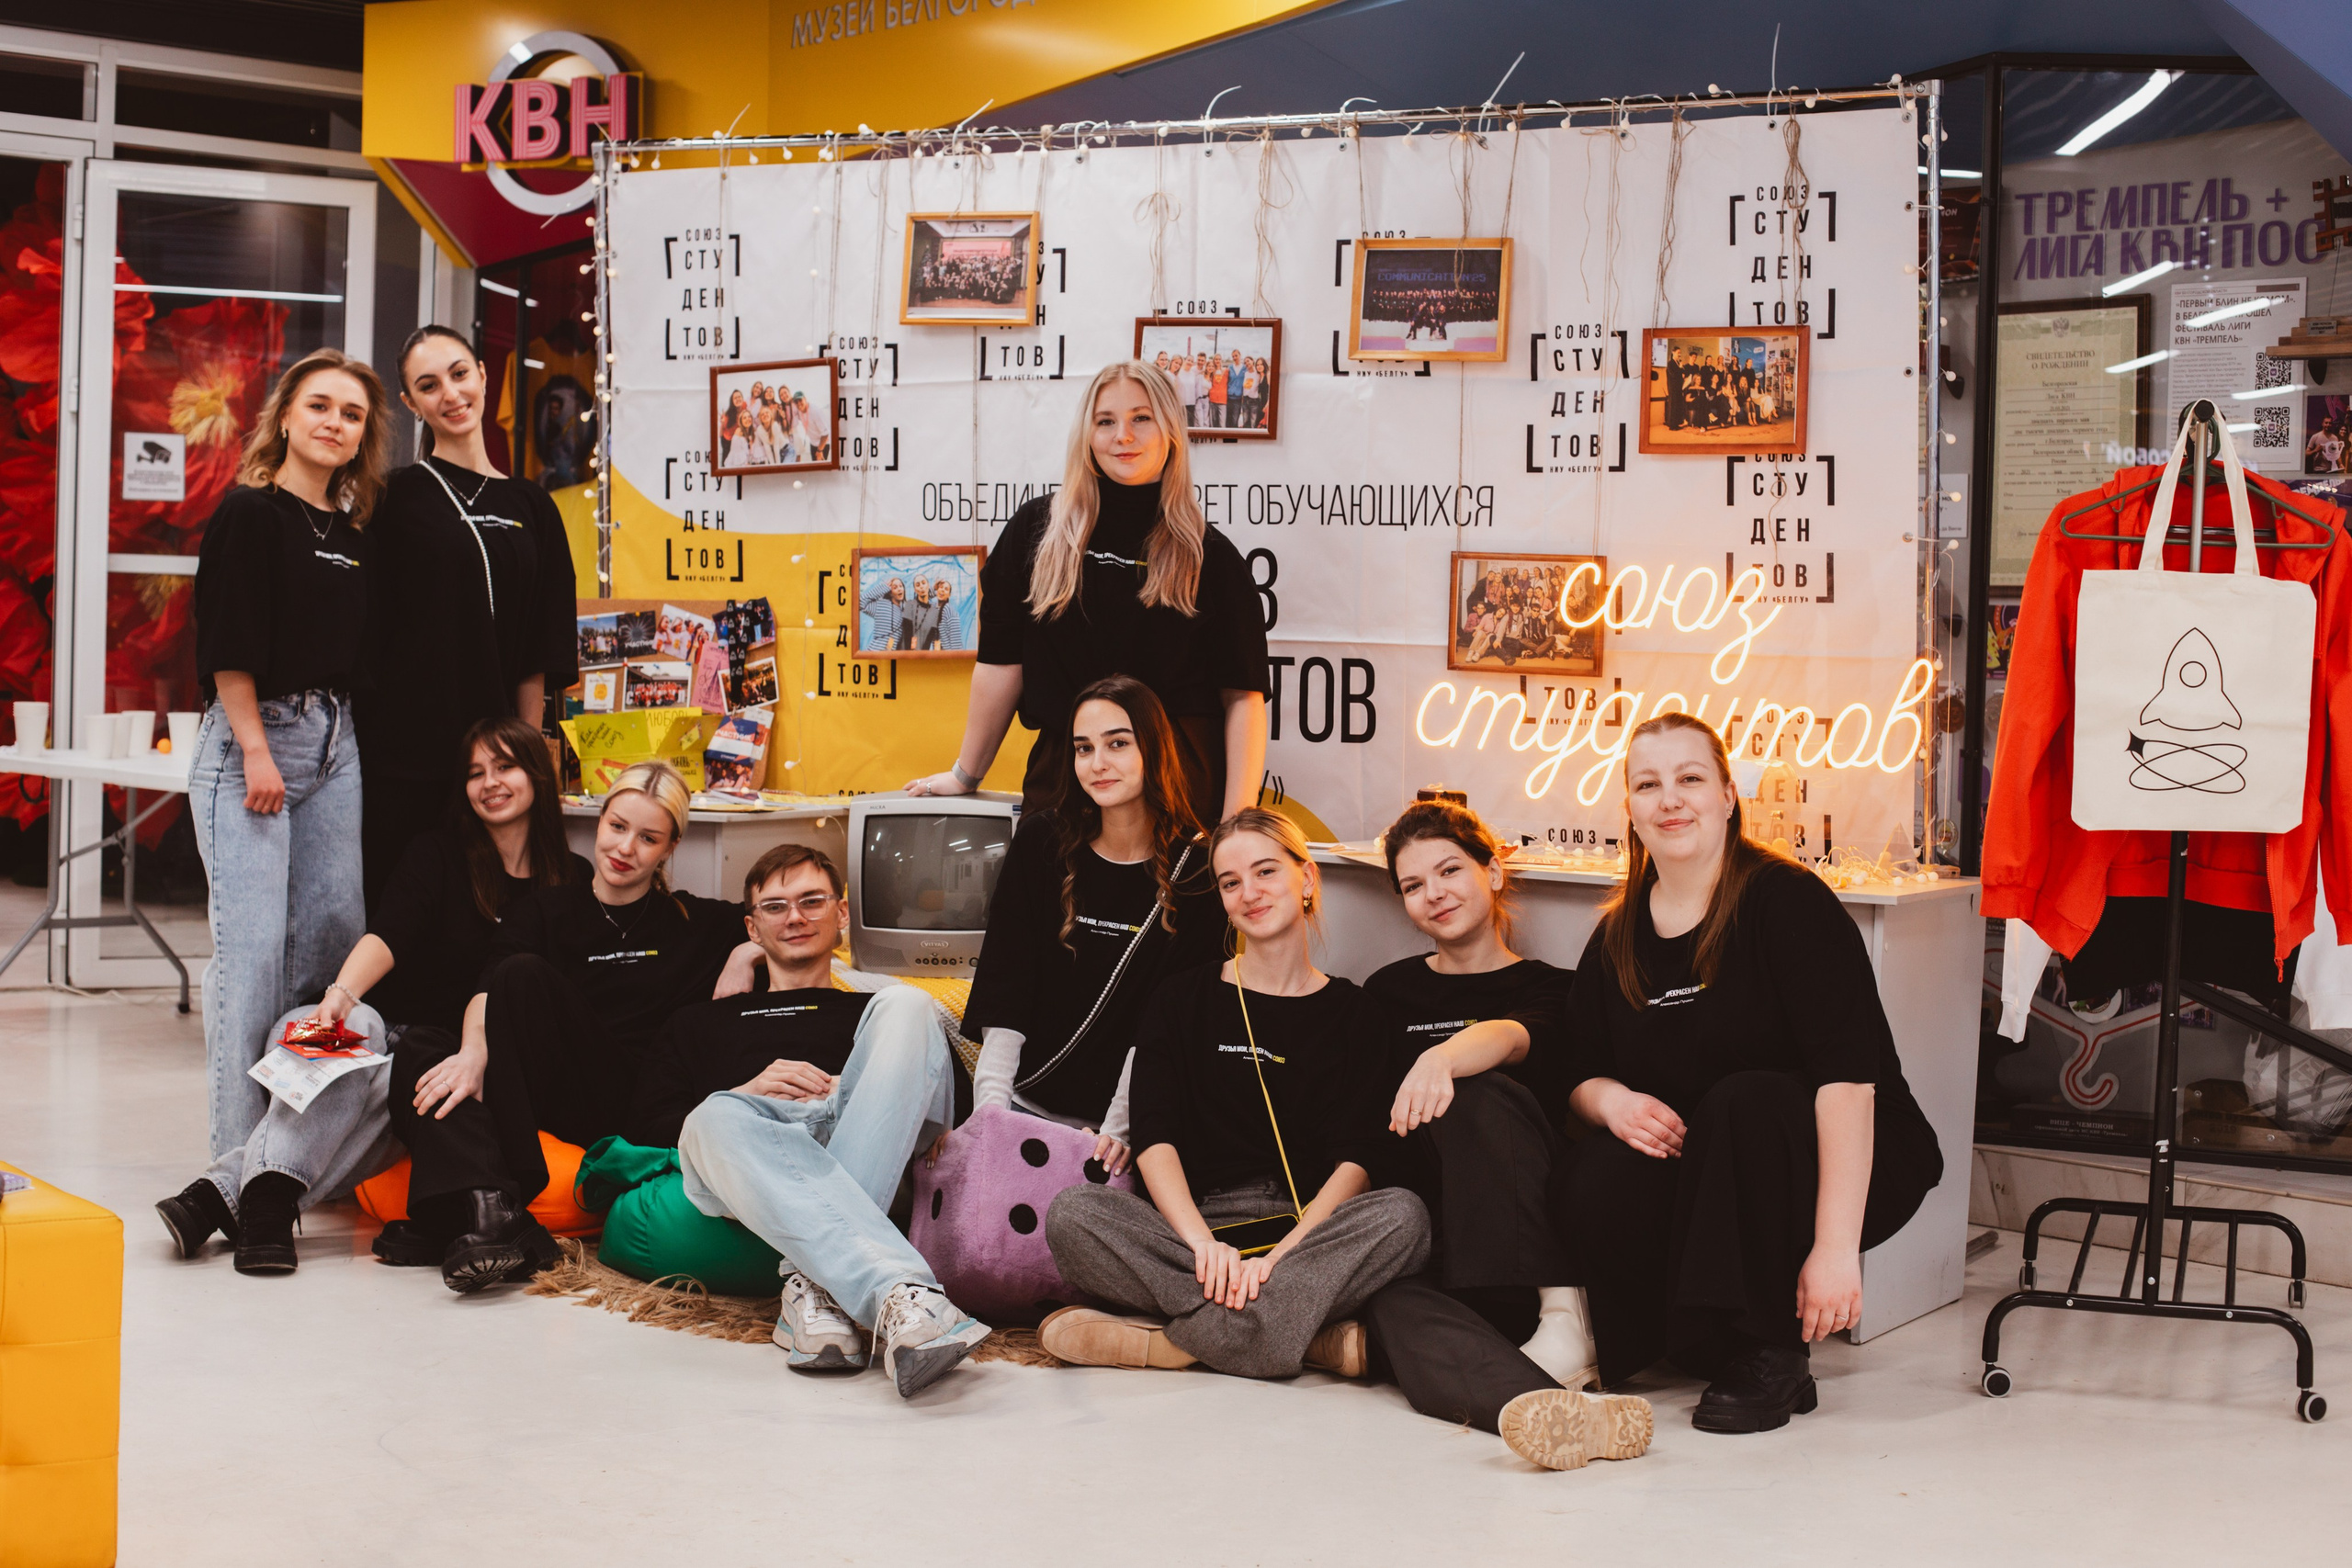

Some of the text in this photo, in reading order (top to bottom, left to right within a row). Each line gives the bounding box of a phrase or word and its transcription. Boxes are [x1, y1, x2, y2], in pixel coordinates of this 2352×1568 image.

[454, 74, 628, 163] КВН
[1757, 185, 1808, 201] СОЮЗ
[2015, 177, 2250, 235] ТРЕМПЕЛЬ
[1755, 209, 1810, 235] СТУ
[685, 228, 721, 242] СОЮЗ
[684, 249, 723, 269] СТУ
[2014, 233, 2106, 281] ЛИГА
[2120, 226, 2211, 275] КВН
[1751, 255, 1811, 283] ДЕН
[682, 288, 724, 310] ДЕН
[1177, 300, 1217, 314] СОЮЗ
[2216, 298, 2239, 307] БЛИН
[1753, 301, 1809, 325] ТОВ
[684, 326, 723, 347] ТОВ
[1555, 323, 1601, 340] СОЮЗ
[2228, 321, 2251, 331] ЛИГИ
[839, 336, 878, 350] СОЮЗ
[2175, 334, 2243, 345] КВН «ТРЕМПЕЛЬ»
[1001, 345, 1044, 367] ТОВ
[1554, 348, 1602, 371] СТУ
[838, 358, 879, 379] СТУ
[838, 398, 879, 421] ДЕН
[1551, 390, 1604, 417] ДЕН
[838, 437, 878, 457] ТОВ
[1551, 434, 1600, 457] ТОВ
[684, 472, 723, 491] СТУ
[1753, 472, 1808, 496] СТУ
[1248, 484, 1494, 531] ОБУЧАЮЩИХСЯ
[683, 510, 725, 532] ДЕН
[1750, 518, 1810, 545] ДЕН
[684, 547, 724, 569] ТОВ
[837, 663, 878, 685] ТОВ
[1548, 829, 1596, 844] СОЮЗ
